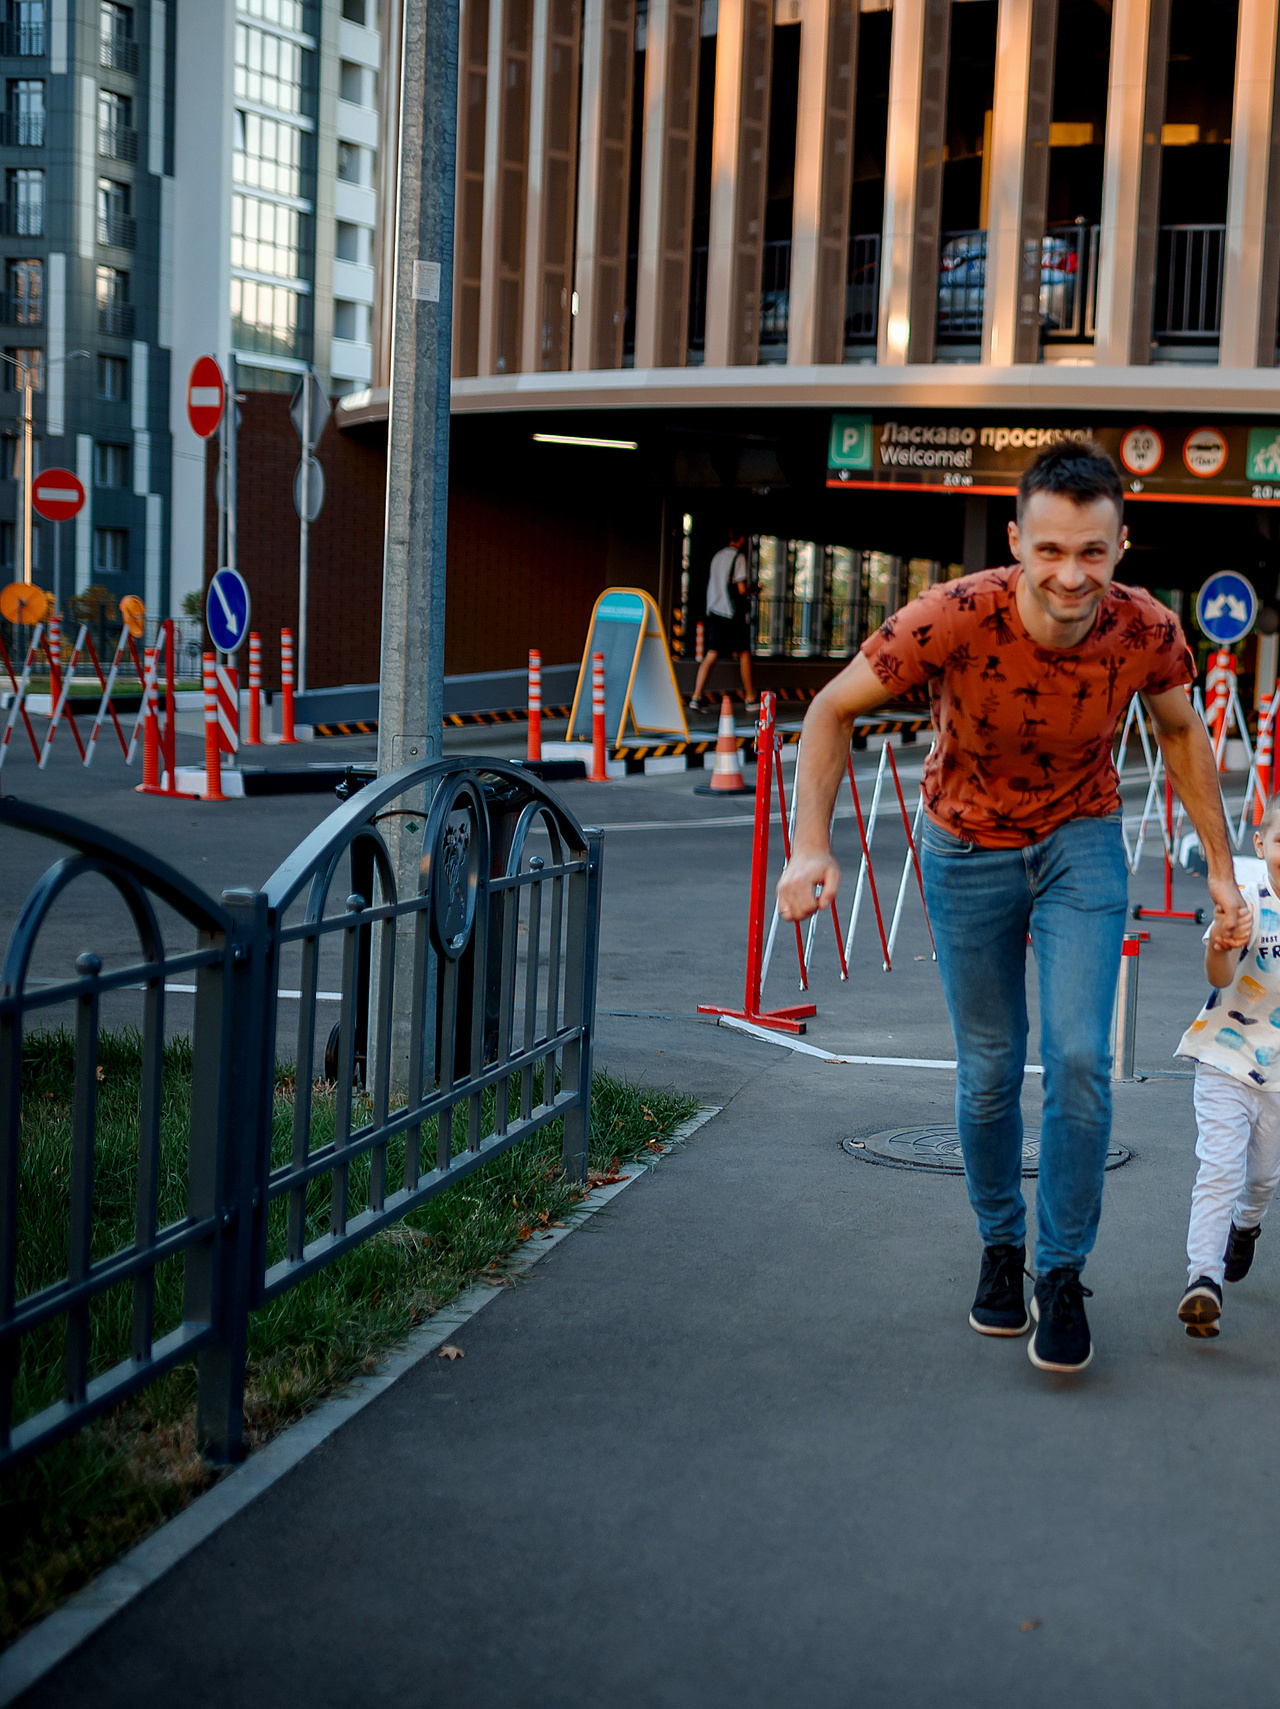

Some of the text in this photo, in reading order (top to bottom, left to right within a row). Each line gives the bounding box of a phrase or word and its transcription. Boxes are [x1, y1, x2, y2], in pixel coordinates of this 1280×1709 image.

[880, 422, 976, 446] Ласкаво
[880, 446, 972, 468] Welcome!
[1261, 935, 1278, 944] BEST
